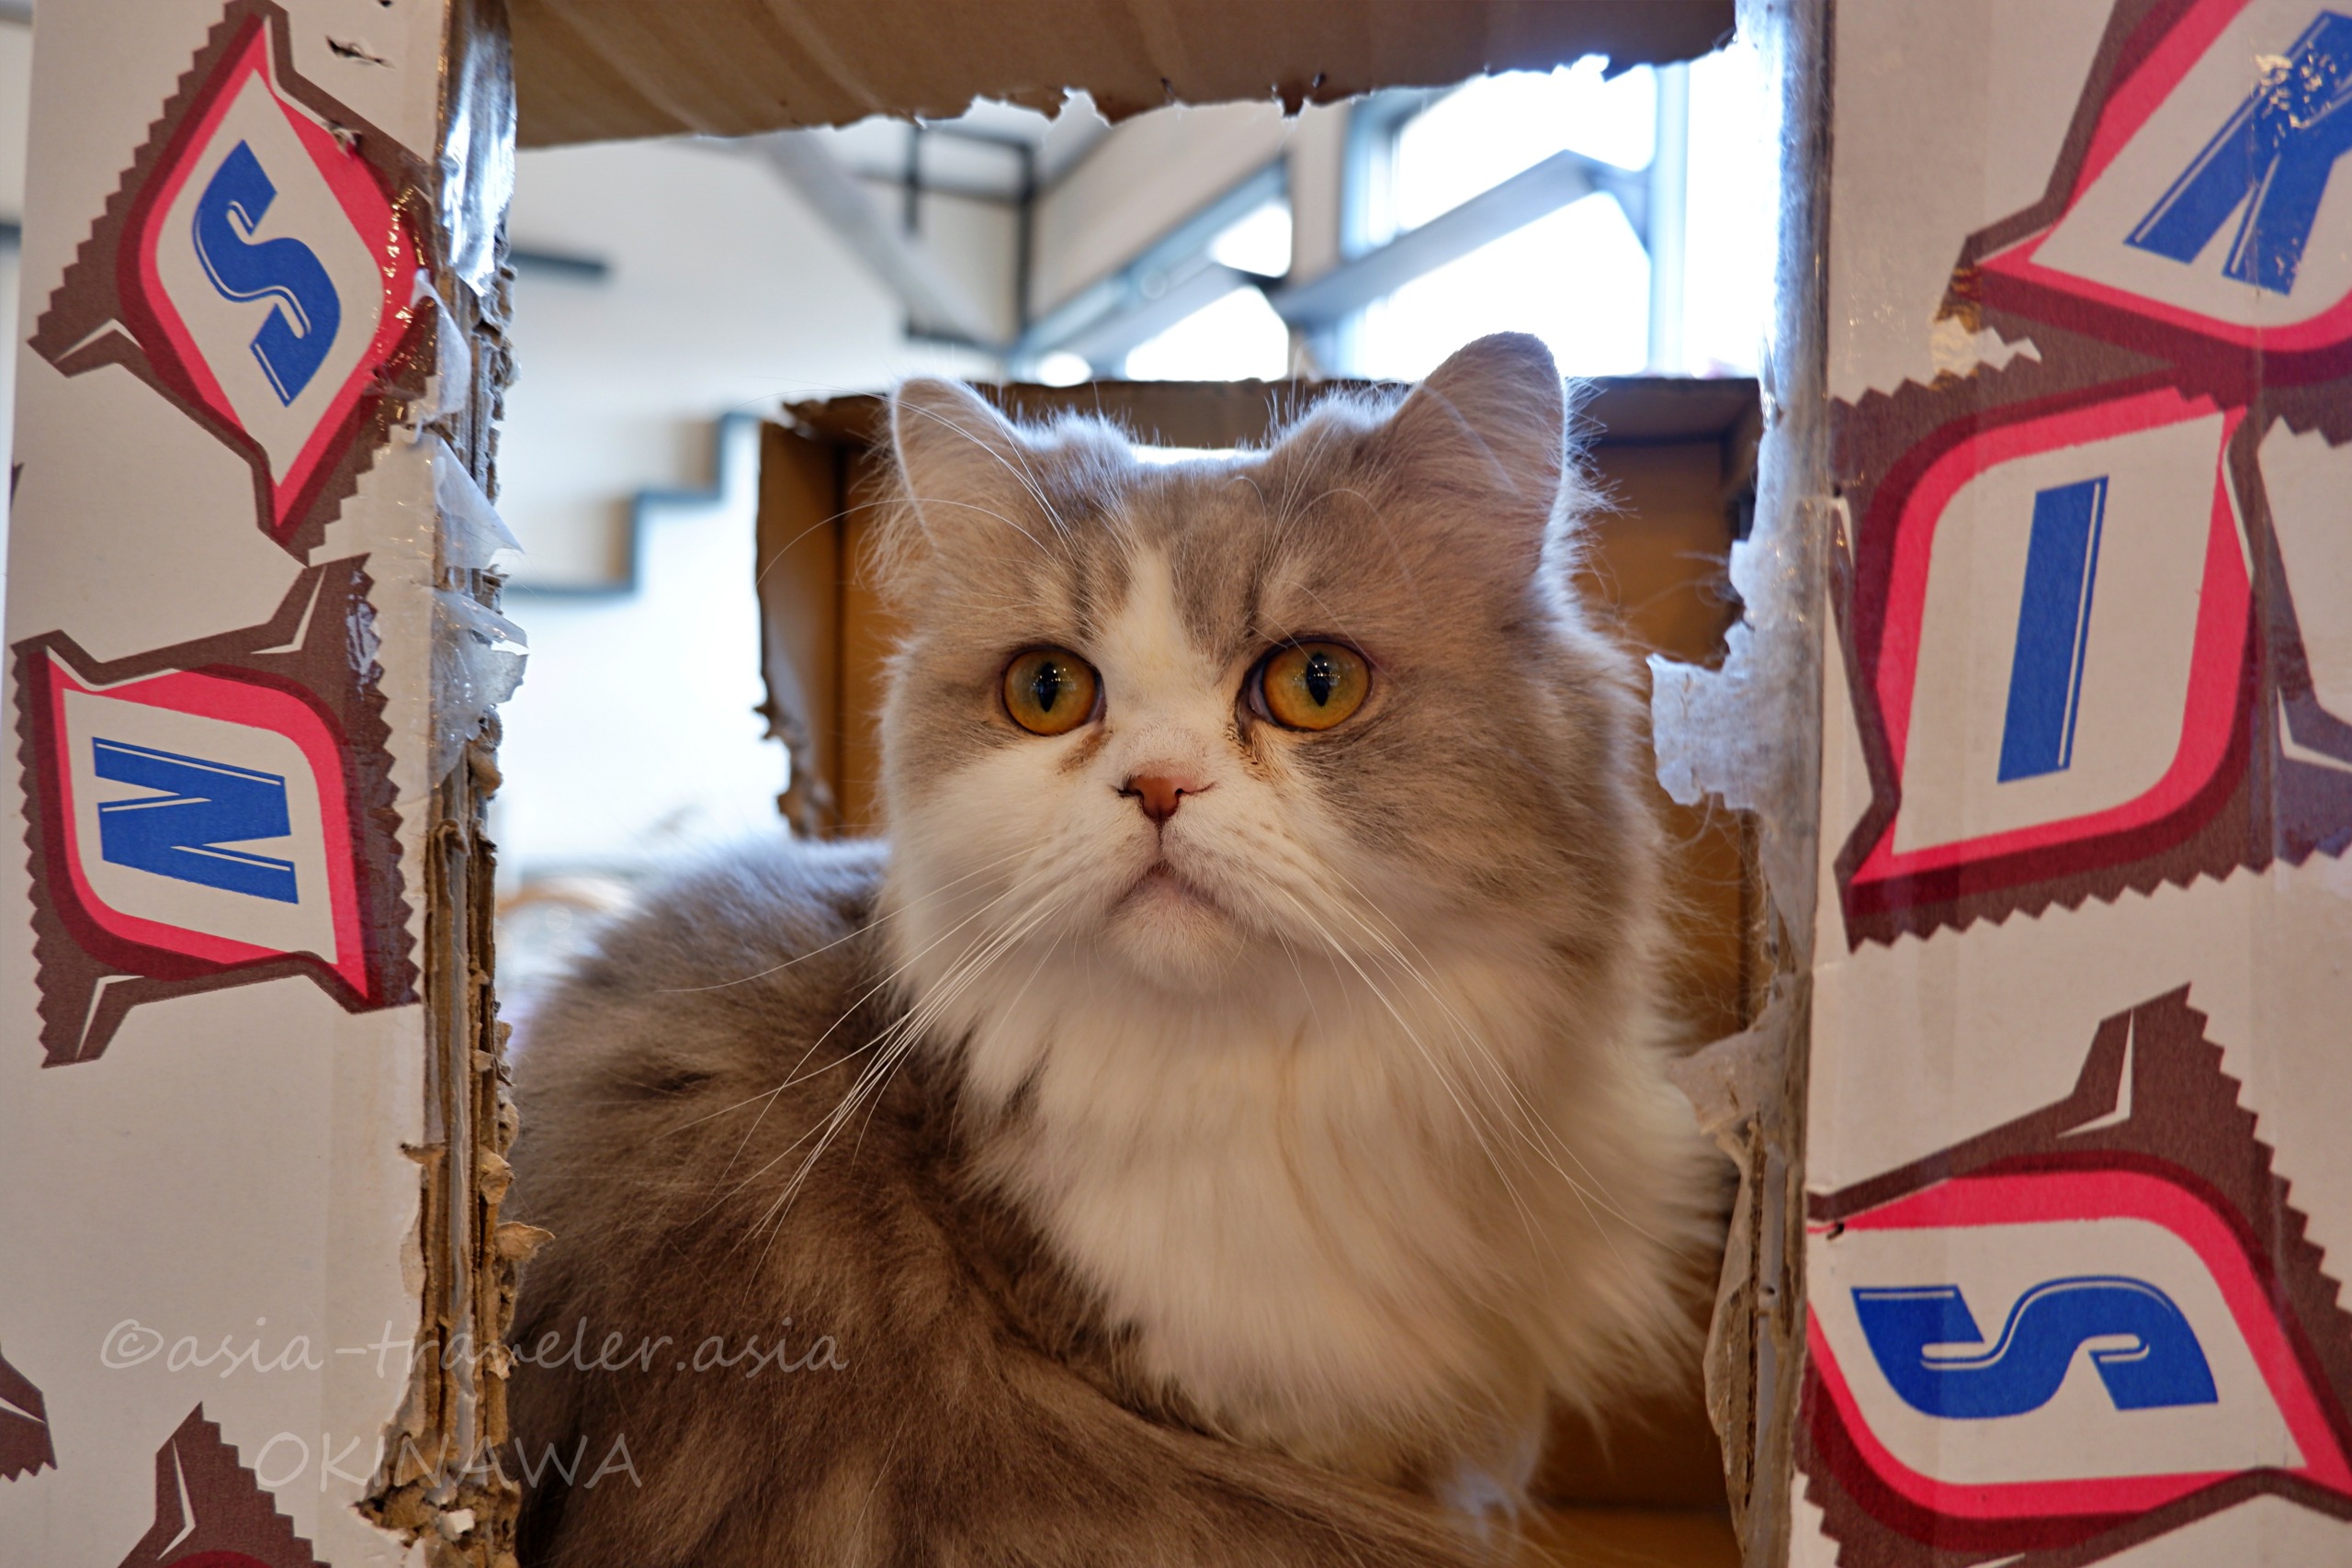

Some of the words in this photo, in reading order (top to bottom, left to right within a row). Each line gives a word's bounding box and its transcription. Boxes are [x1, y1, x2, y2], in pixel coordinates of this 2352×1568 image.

[192, 140, 341, 407] S
[1996, 475, 2109, 784] I
[92, 737, 299, 905] N
[1850, 1275, 2218, 1420] S
